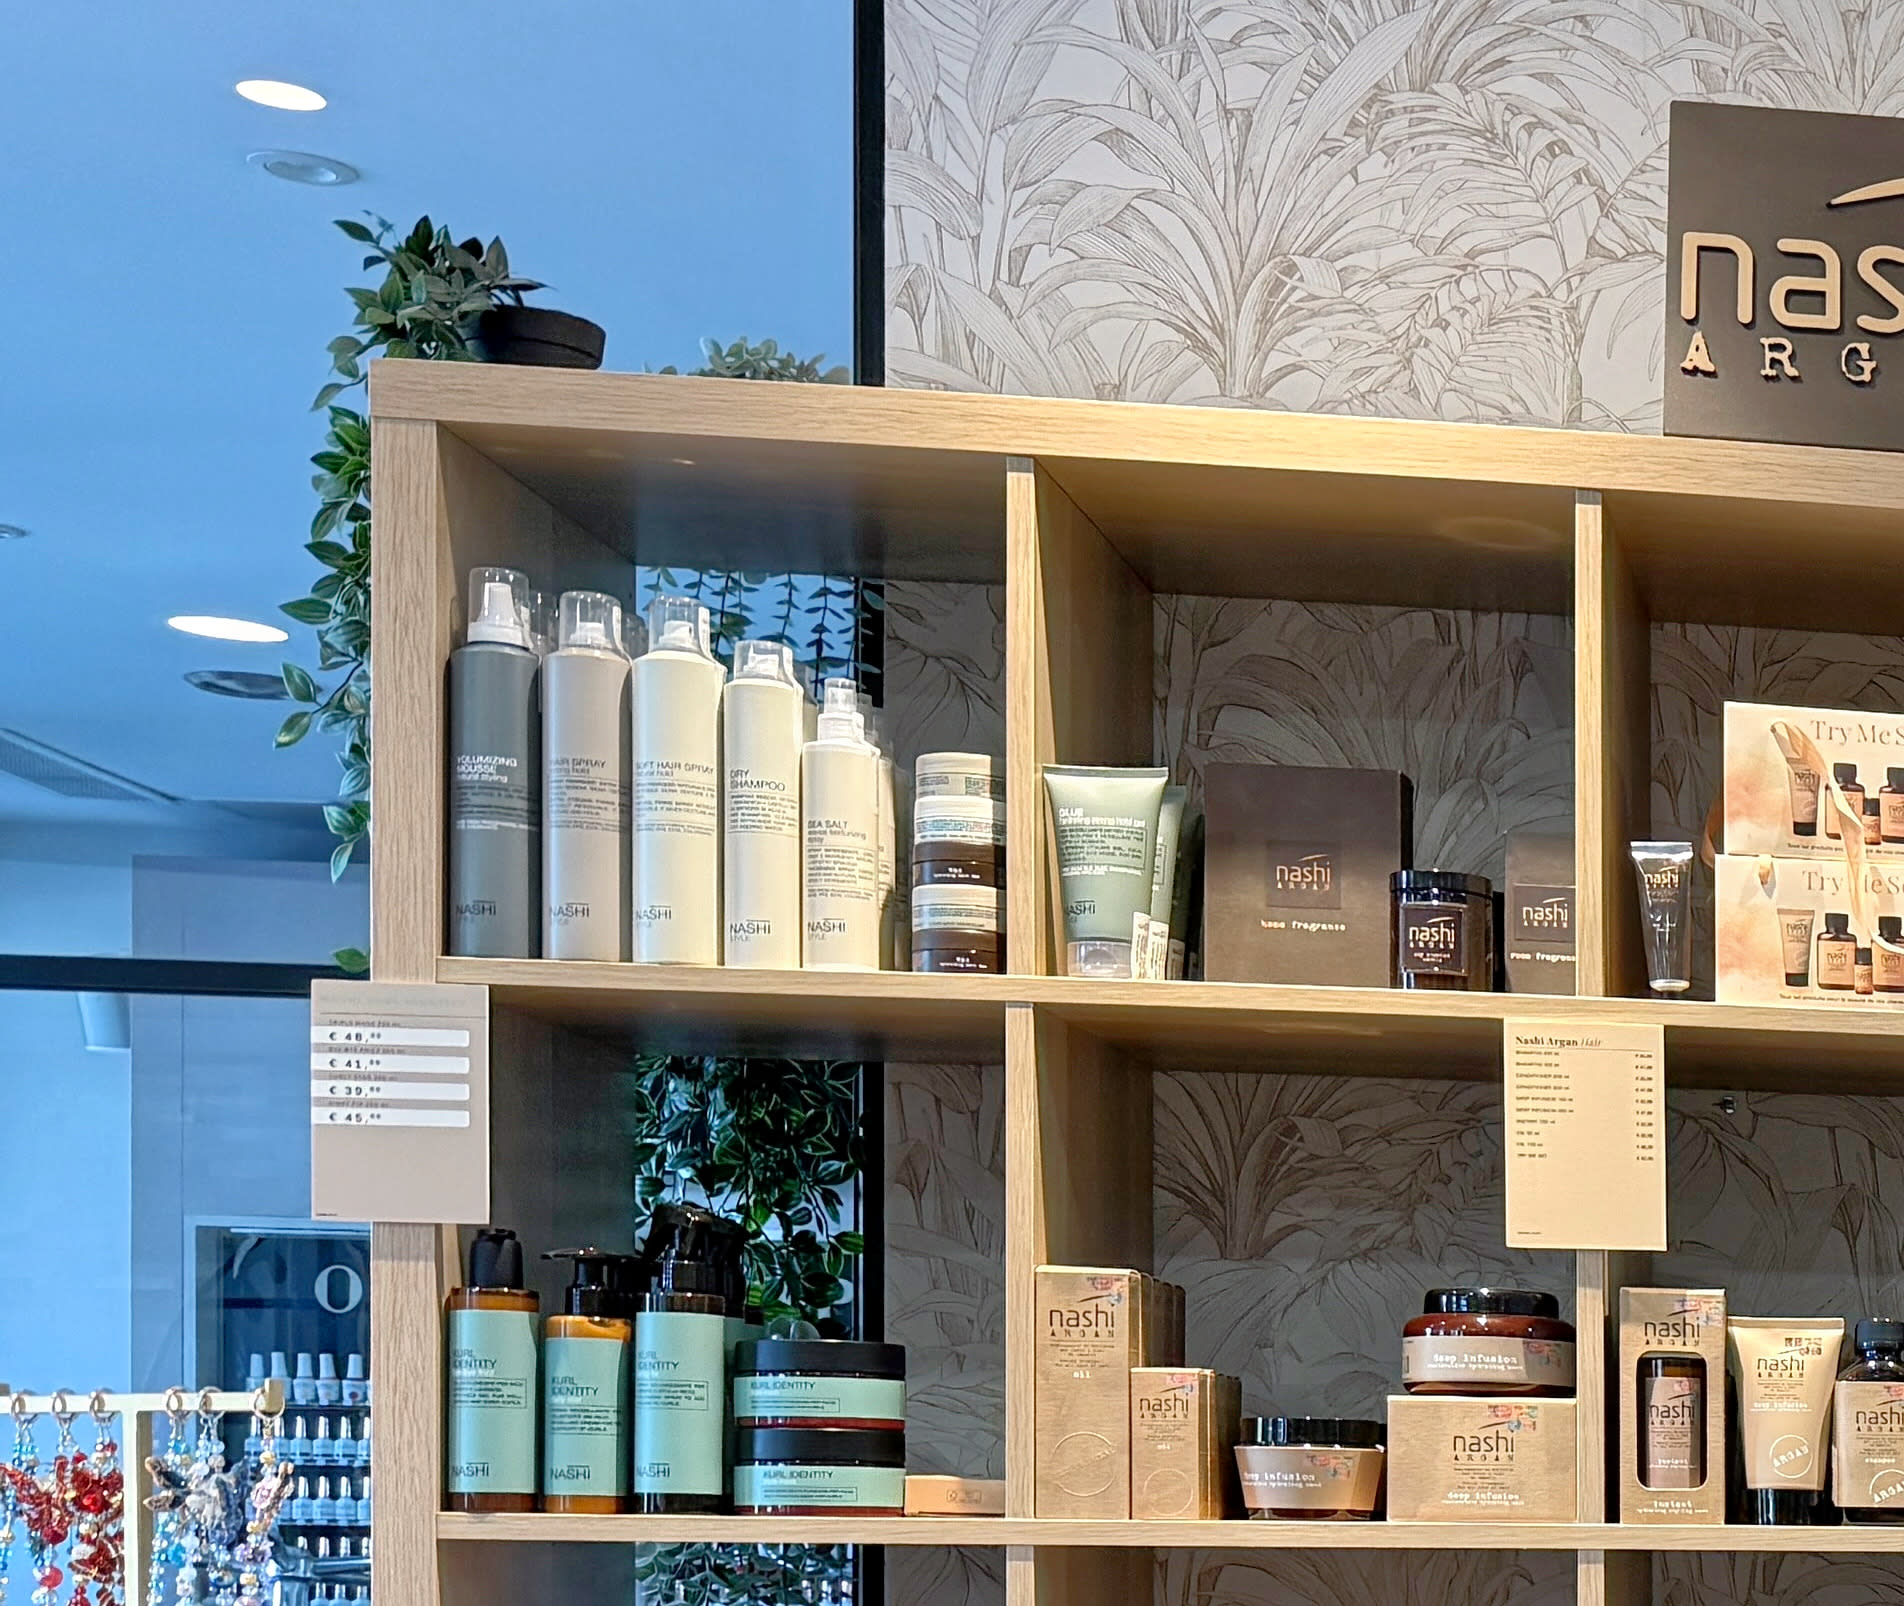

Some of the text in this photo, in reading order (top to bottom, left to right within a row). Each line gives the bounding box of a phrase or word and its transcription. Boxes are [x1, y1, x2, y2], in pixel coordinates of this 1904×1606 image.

[1810, 720, 1852, 746] Try
[1858, 724, 1890, 746] Me
[730, 779, 786, 792] SHAMPOO
[826, 820, 848, 829] SALT
[1276, 861, 1331, 883] nashi
[1802, 870, 1843, 896] Try
[550, 904, 590, 917] NASHI
[1522, 903, 1568, 920] nashi
[730, 922, 771, 934] NASHI
[808, 920, 845, 932] NASHI
[1409, 923, 1455, 942] nashi
[329, 1032, 337, 1041] €
[1516, 1036, 1544, 1046] Nashi
[1547, 1037, 1578, 1048] Argan
[329, 1059, 337, 1068] €
[329, 1086, 337, 1095] €
[329, 1113, 337, 1122] €
[1050, 1303, 1114, 1328] nashi
[1644, 1316, 1700, 1338] nashi
[1433, 1353, 1517, 1364] deep infusion
[1757, 1355, 1804, 1371] nashi
[552, 1386, 598, 1396] IDENTITY
[773, 1382, 815, 1391] IDENTITY
[1140, 1393, 1189, 1412] nashi
[1649, 1400, 1695, 1419] nashi
[1856, 1405, 1904, 1425] nashi
[1453, 1429, 1514, 1453] nashi
[1772, 1445, 1809, 1467] ARGAN
[551, 1467, 590, 1479] NASHI
[788, 1470, 833, 1479] IDENTITY
[1475, 1492, 1520, 1500] infusion
